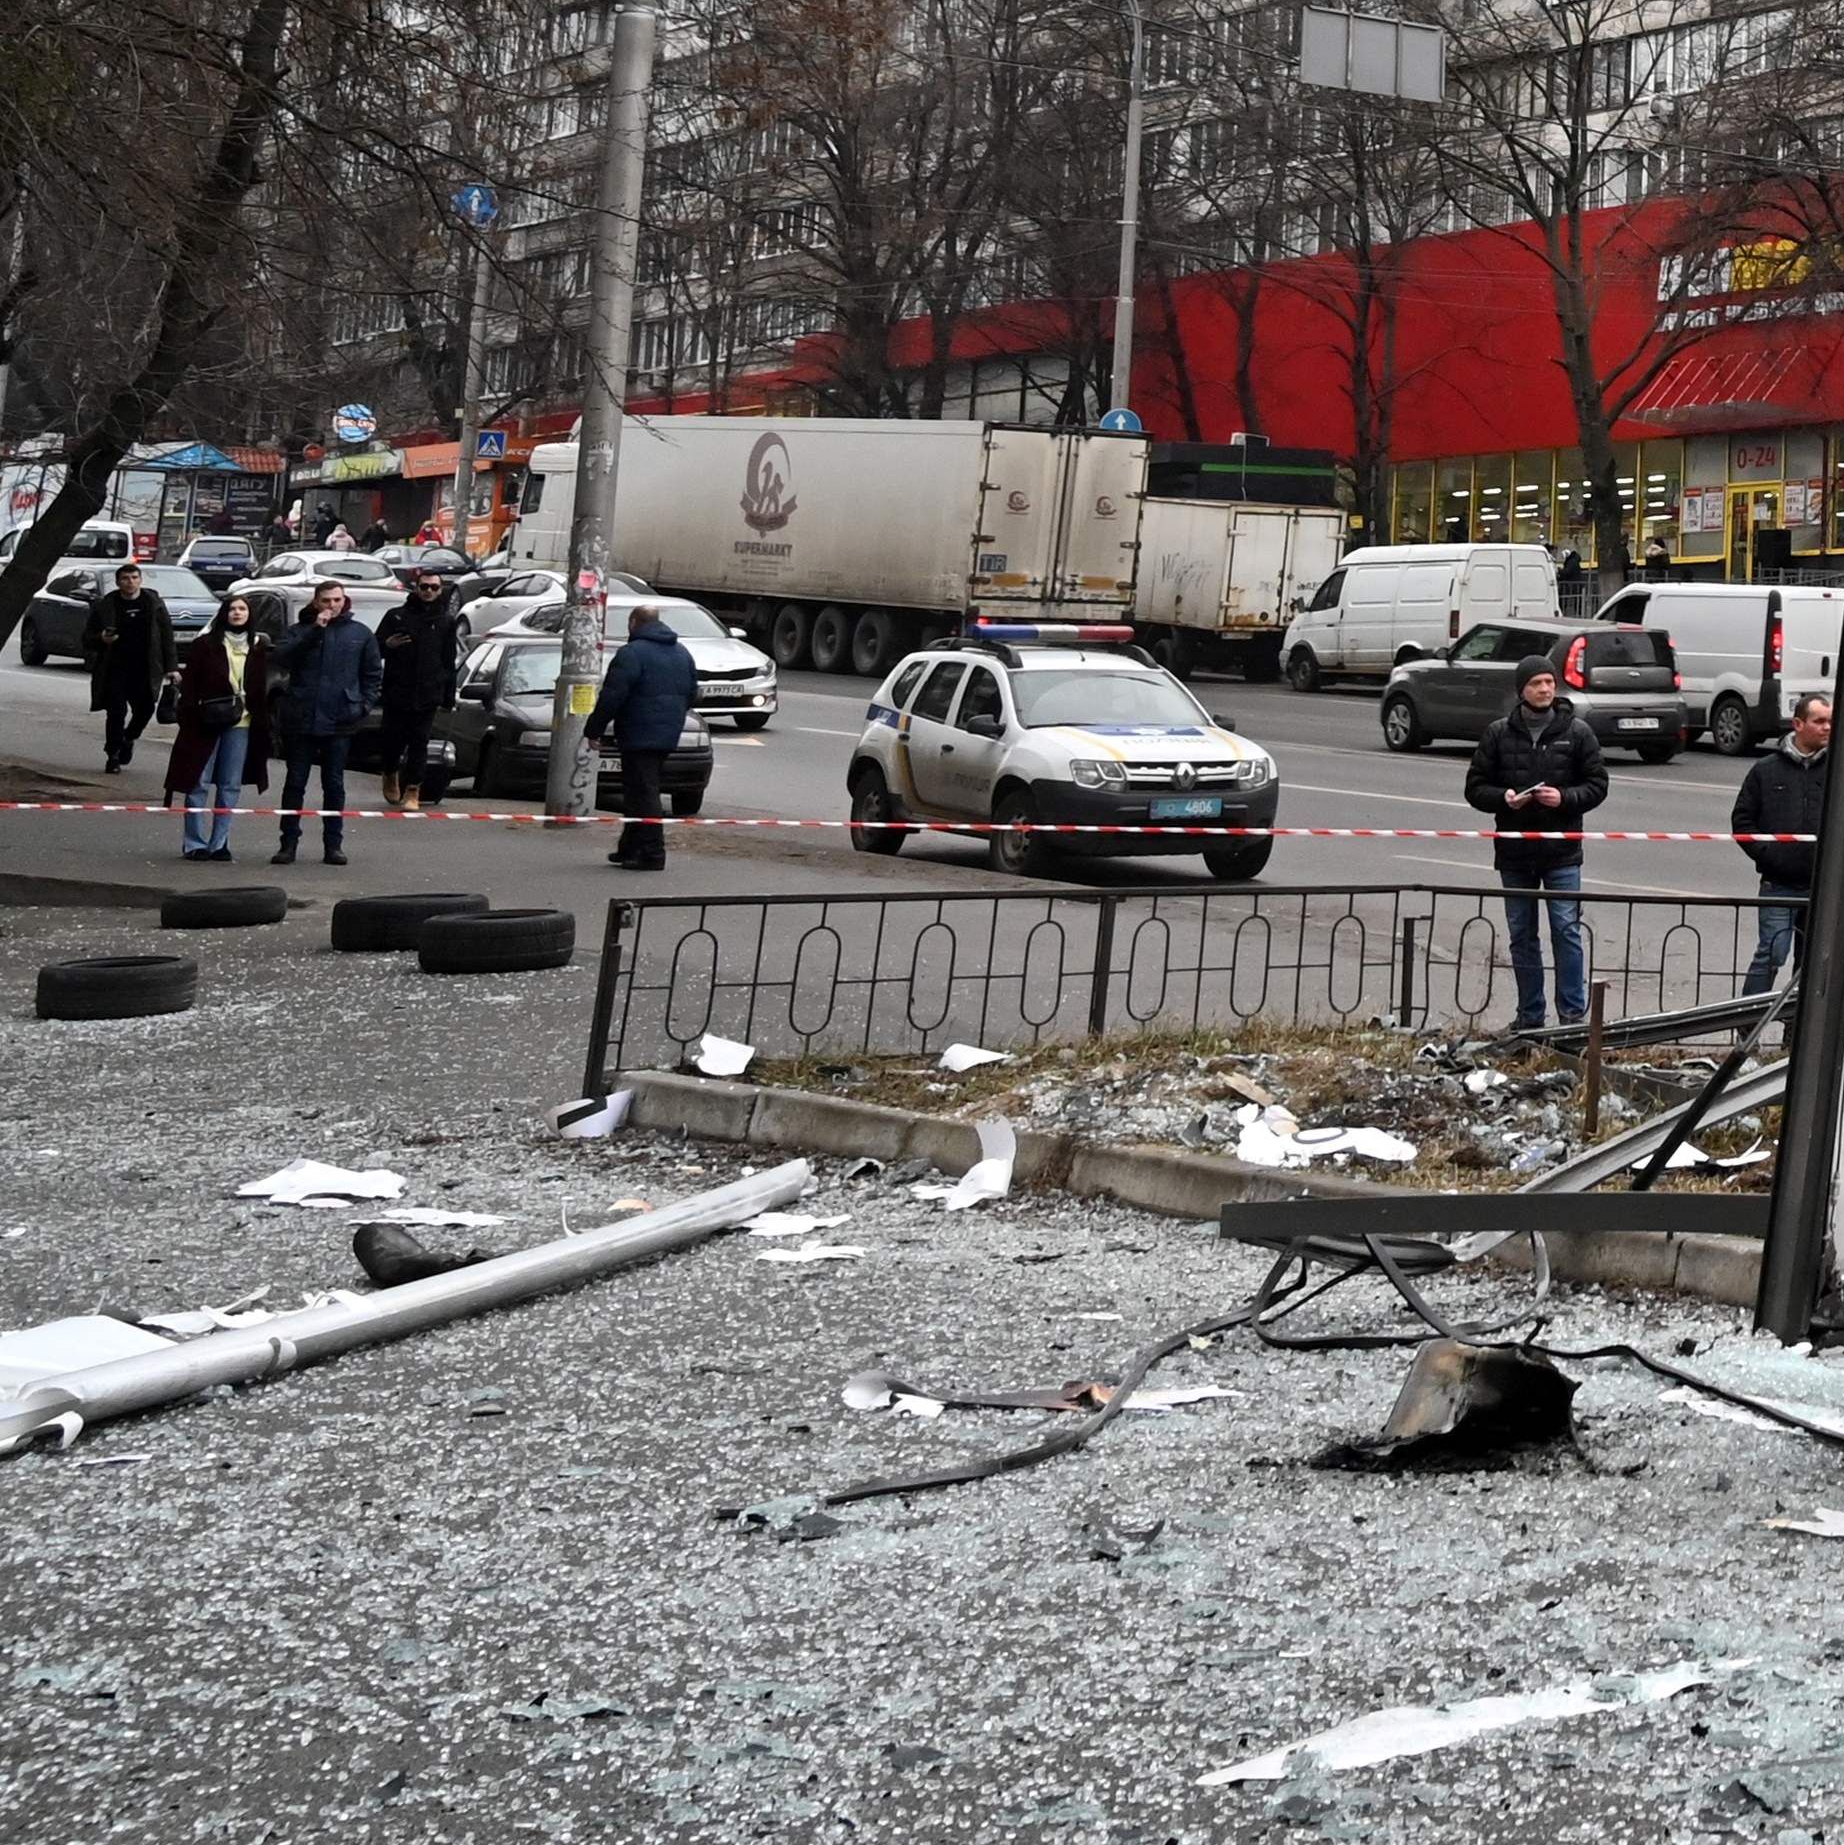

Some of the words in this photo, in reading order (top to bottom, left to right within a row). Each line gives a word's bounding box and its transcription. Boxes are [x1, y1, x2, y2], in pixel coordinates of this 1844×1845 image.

[1737, 446, 1776, 469] 0-24
[981, 555, 1005, 572] TIR
[1184, 799, 1213, 815] 4806
